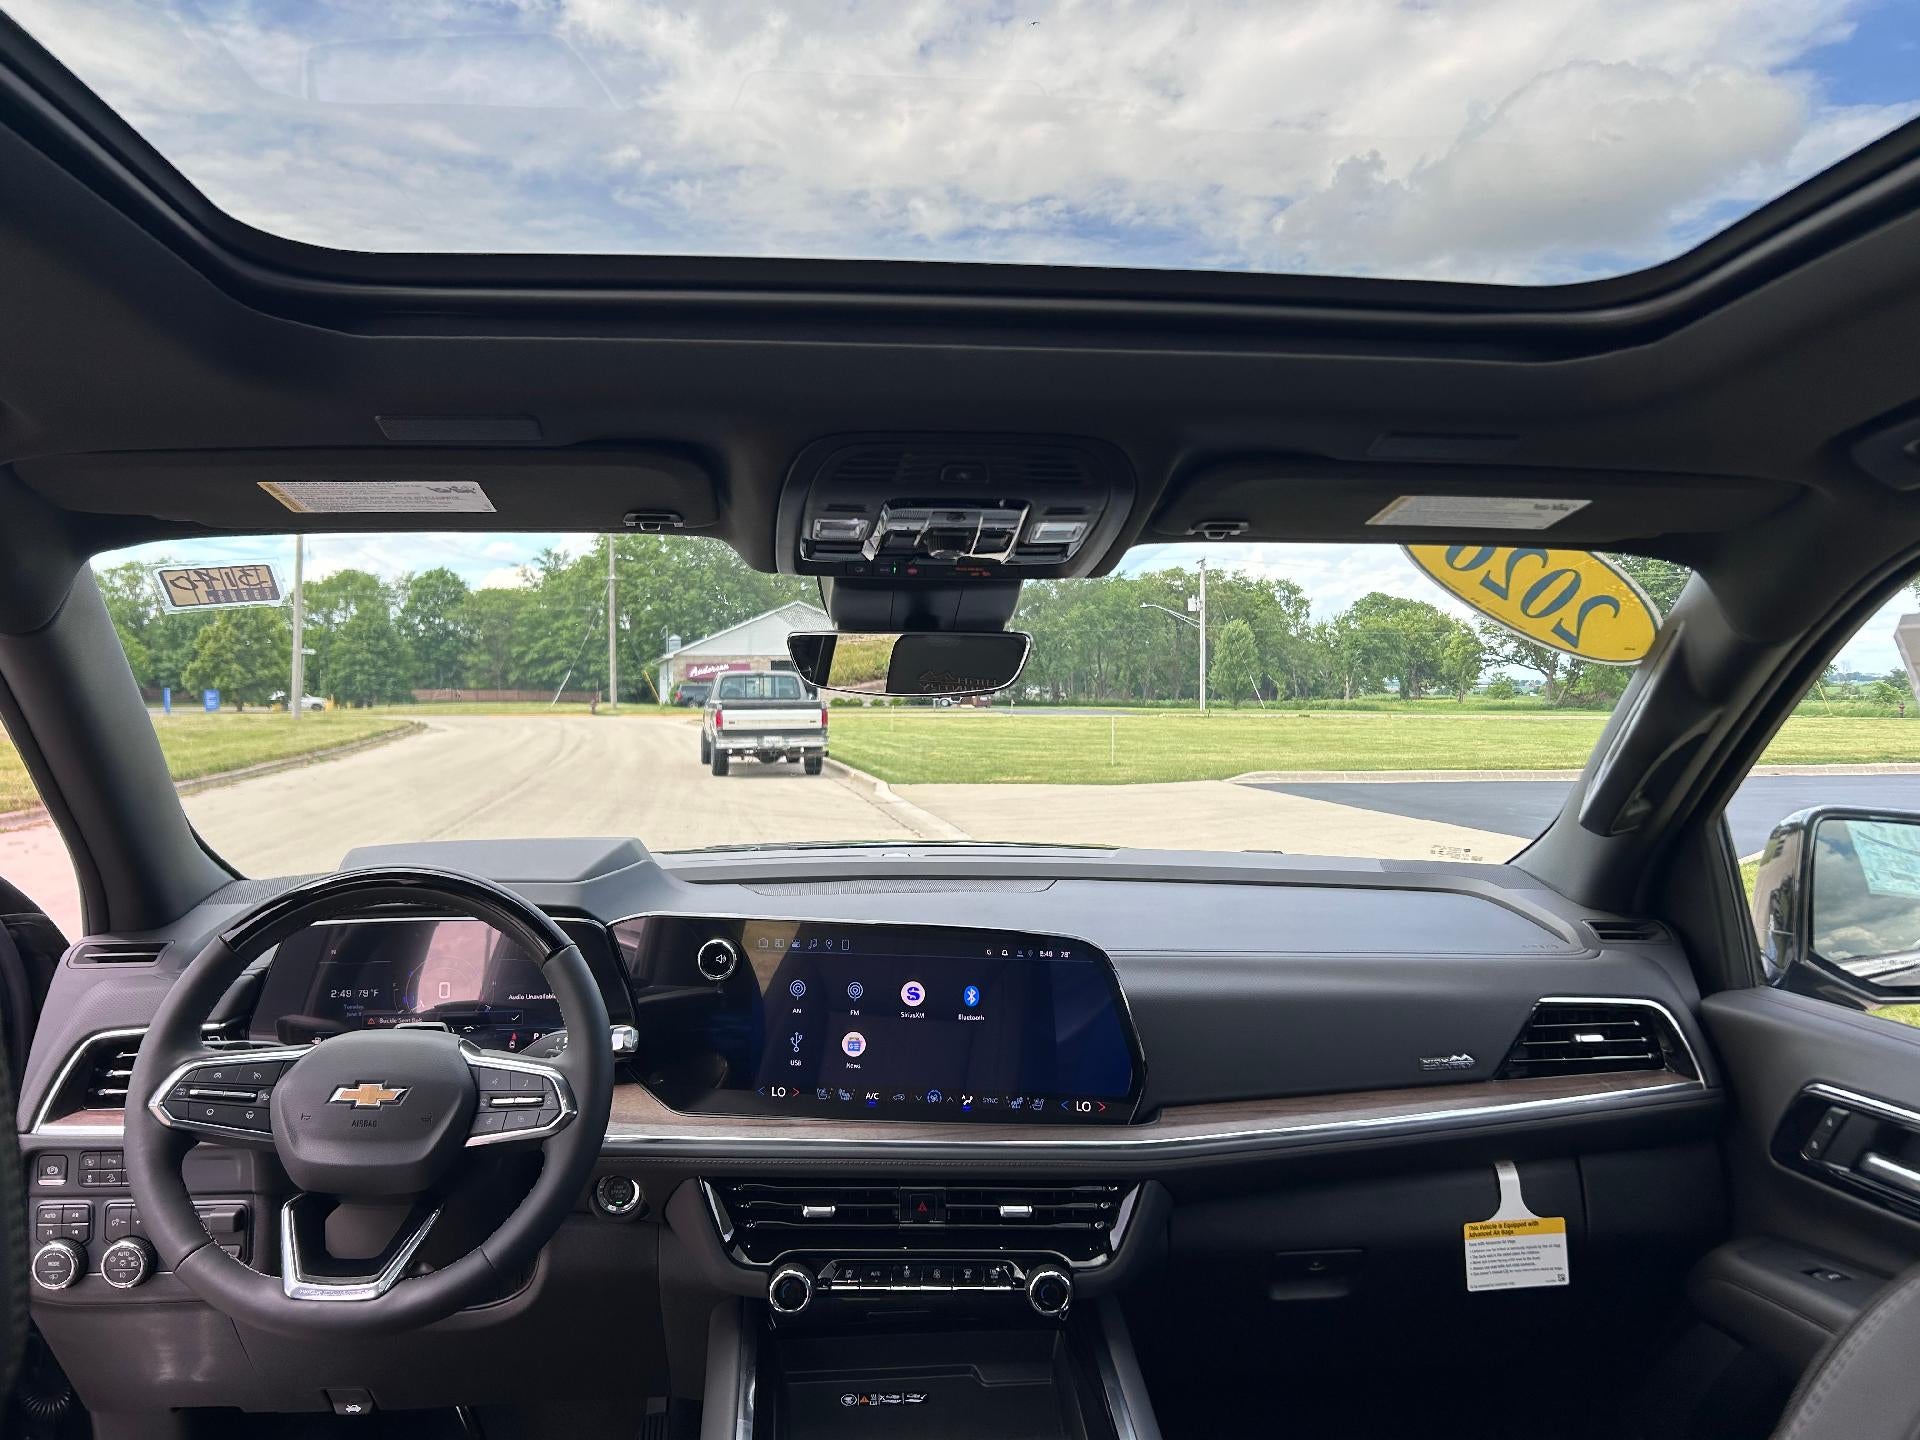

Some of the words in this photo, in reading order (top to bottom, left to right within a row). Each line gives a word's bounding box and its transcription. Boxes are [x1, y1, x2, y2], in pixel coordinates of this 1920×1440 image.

[330, 989, 352, 998] 2:49
[900, 1011, 925, 1019] SiriusXM
[958, 1013, 985, 1021] Bluetooth
[790, 1059, 802, 1067] USB
[771, 1087, 786, 1097] LO
[865, 1091, 879, 1101] A/C
[1075, 1101, 1092, 1112] LO
[351, 1119, 377, 1128] AIRBAG
[1479, 1222, 1498, 1230] Vehicle
[1503, 1221, 1527, 1230] Equipped
